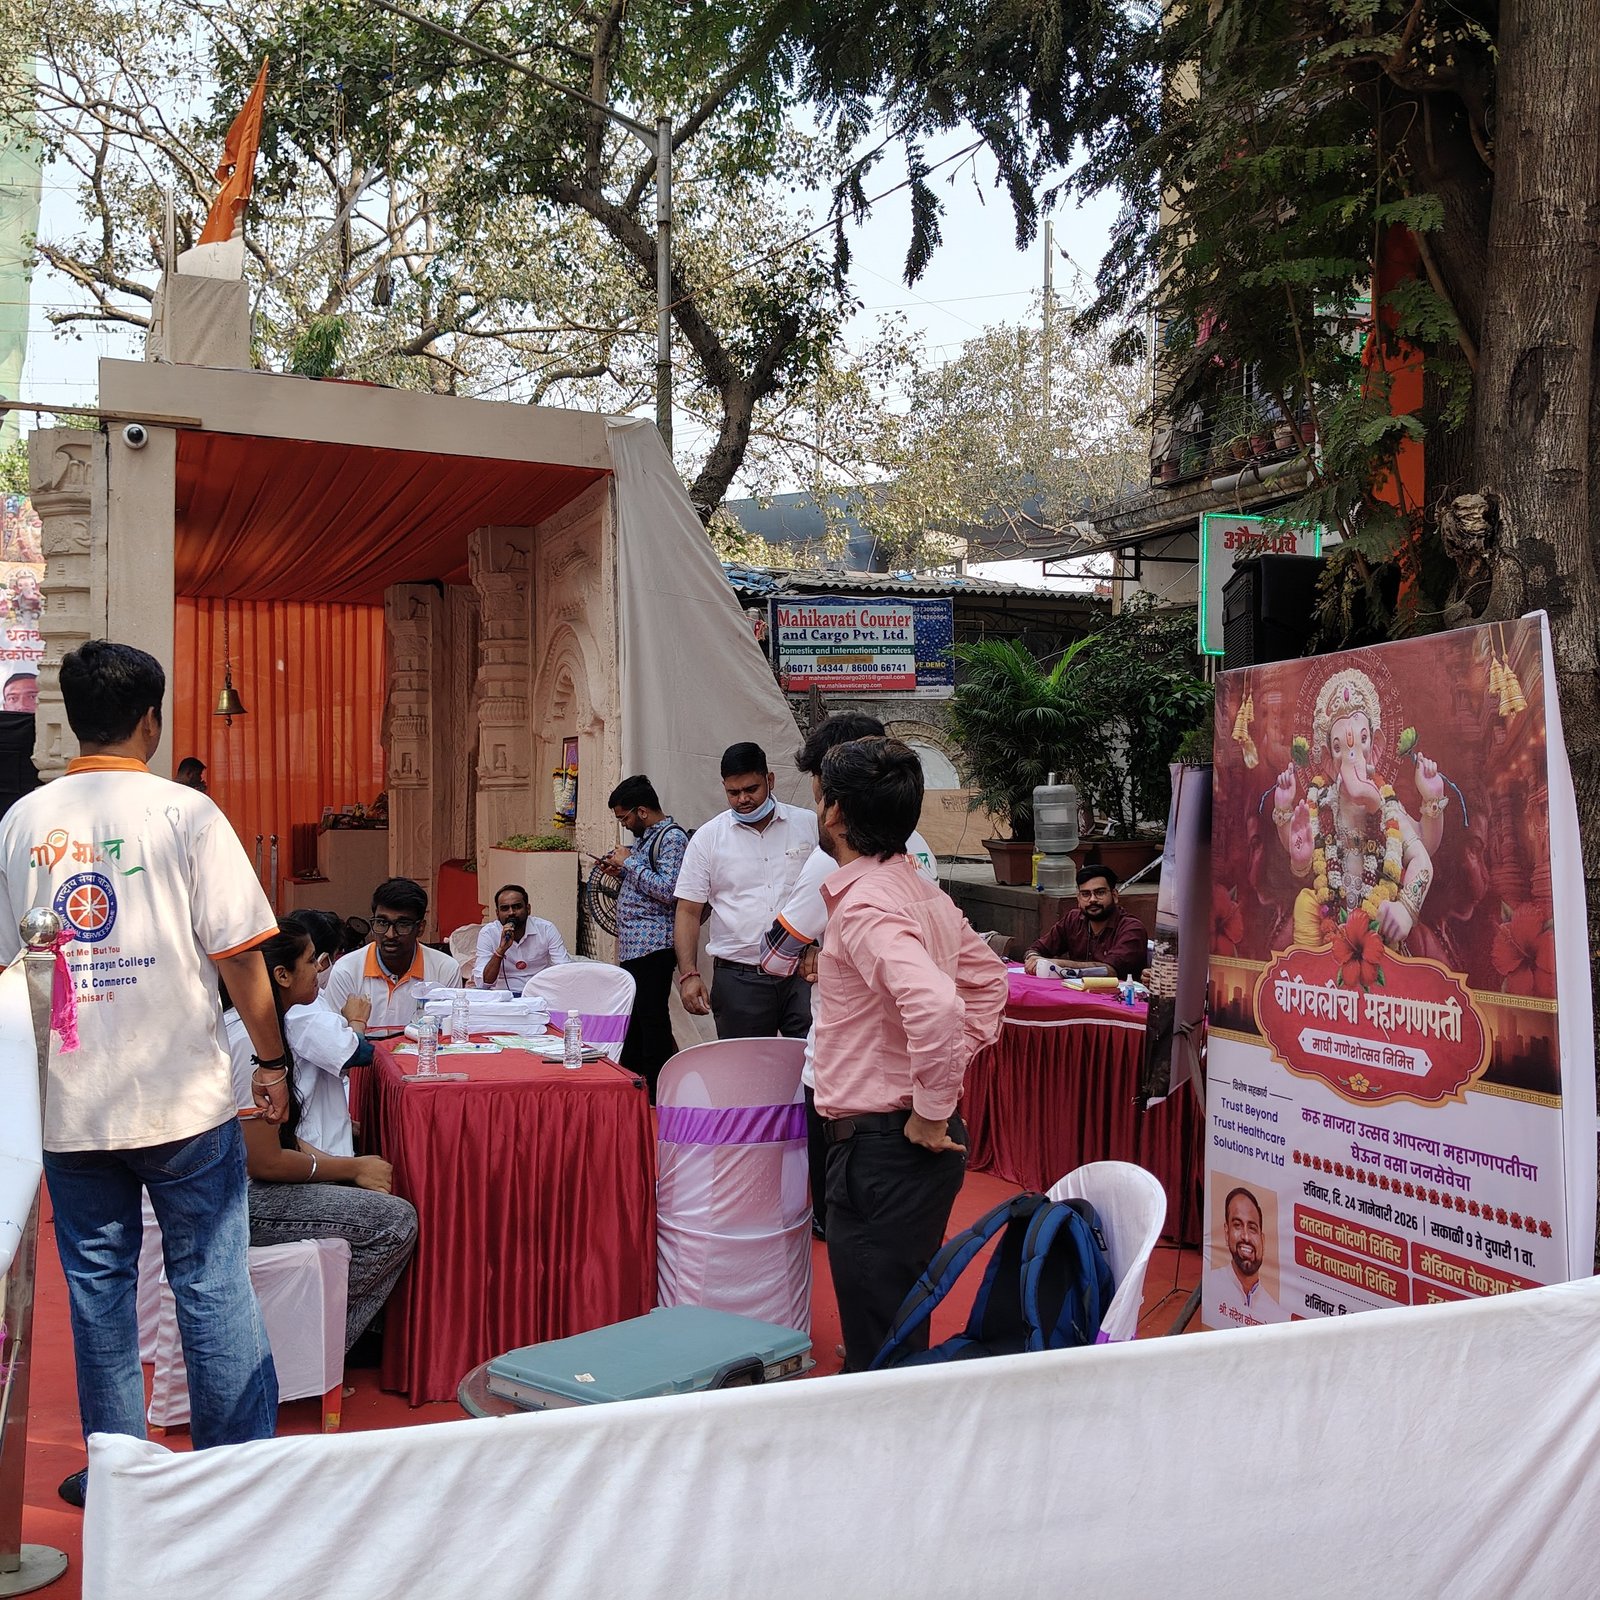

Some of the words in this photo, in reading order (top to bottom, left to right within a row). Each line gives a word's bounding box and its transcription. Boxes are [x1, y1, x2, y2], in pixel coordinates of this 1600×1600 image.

[777, 608, 857, 627] Mahikavati
[860, 608, 911, 627] Courier
[780, 646, 813, 654] Domestic
[815, 646, 830, 654] and
[832, 646, 880, 654] International
[882, 646, 911, 654] Services
[782, 629, 807, 640] and
[810, 629, 849, 643] Cargo
[853, 629, 879, 640] Pvt.
[883, 629, 908, 640] Ltd.
[816, 664, 843, 673] 34344
[851, 663, 878, 672] 86000
[881, 663, 907, 672] 66741
[63, 950, 75, 958] ot
[76, 949, 90, 957] Me
[92, 947, 108, 955] But
[108, 945, 121, 954] You
[67, 961, 116, 973] amnarayan
[118, 956, 156, 968] College
[76, 992, 105, 1003] ahisar
[106, 990, 115, 1003] (E)
[81, 979, 88, 989] &
[92, 976, 138, 988] Commerce
[1274, 969, 1359, 1025] बोरीवलीचा
[1363, 995, 1463, 1043] महागणपती
[1312, 1036, 1332, 1053] माघी
[1334, 1040, 1381, 1064] गणेशोत्सव
[1383, 1047, 1415, 1071] निमित्त
[1232, 1078, 1248, 1092] विशेष
[1248, 1086, 1268, 1098] सहकार्य
[1221, 1097, 1243, 1113] Trust
[1245, 1103, 1278, 1122] Beyond
[1213, 1114, 1235, 1131] Trust
[1237, 1122, 1286, 1146] Healthcare
[1213, 1135, 1254, 1157] Solutions
[1255, 1147, 1269, 1162] Pvt
[1271, 1152, 1285, 1167] Ltd
[1323, 1113, 1356, 1135] साजरा
[1357, 1122, 1390, 1144] उत्सव
[1393, 1131, 1440, 1157] आपल्या
[1443, 1143, 1538, 1182] महागणपतीचा
[1350, 1141, 1381, 1167] घेऊन
[1383, 1154, 1407, 1175] वसा
[1410, 1161, 1471, 1192] जनसेवेचा
[1303, 1180, 1331, 1206] रविवार,
[1332, 1188, 1343, 1207] दि.
[1344, 1195, 1356, 1211] 24
[1357, 1199, 1393, 1223] जानेवारी
[1394, 1210, 1418, 1230] 2026
[1430, 1221, 1464, 1245] सकाळी
[1466, 1232, 1473, 1248] 9
[1474, 1231, 1483, 1251] ते
[1484, 1239, 1512, 1260] दुपारी
[1514, 1247, 1519, 1262] 1
[1521, 1249, 1536, 1268] वा.
[1299, 1213, 1333, 1240] मतदान
[1334, 1223, 1367, 1252] नोंदणी
[1369, 1233, 1402, 1264] शिबिर
[1305, 1245, 1322, 1270] नेत्र
[1323, 1255, 1363, 1285] तपासणी
[1364, 1266, 1398, 1297] शिबिर
[1419, 1251, 1465, 1286] मेडिकल
